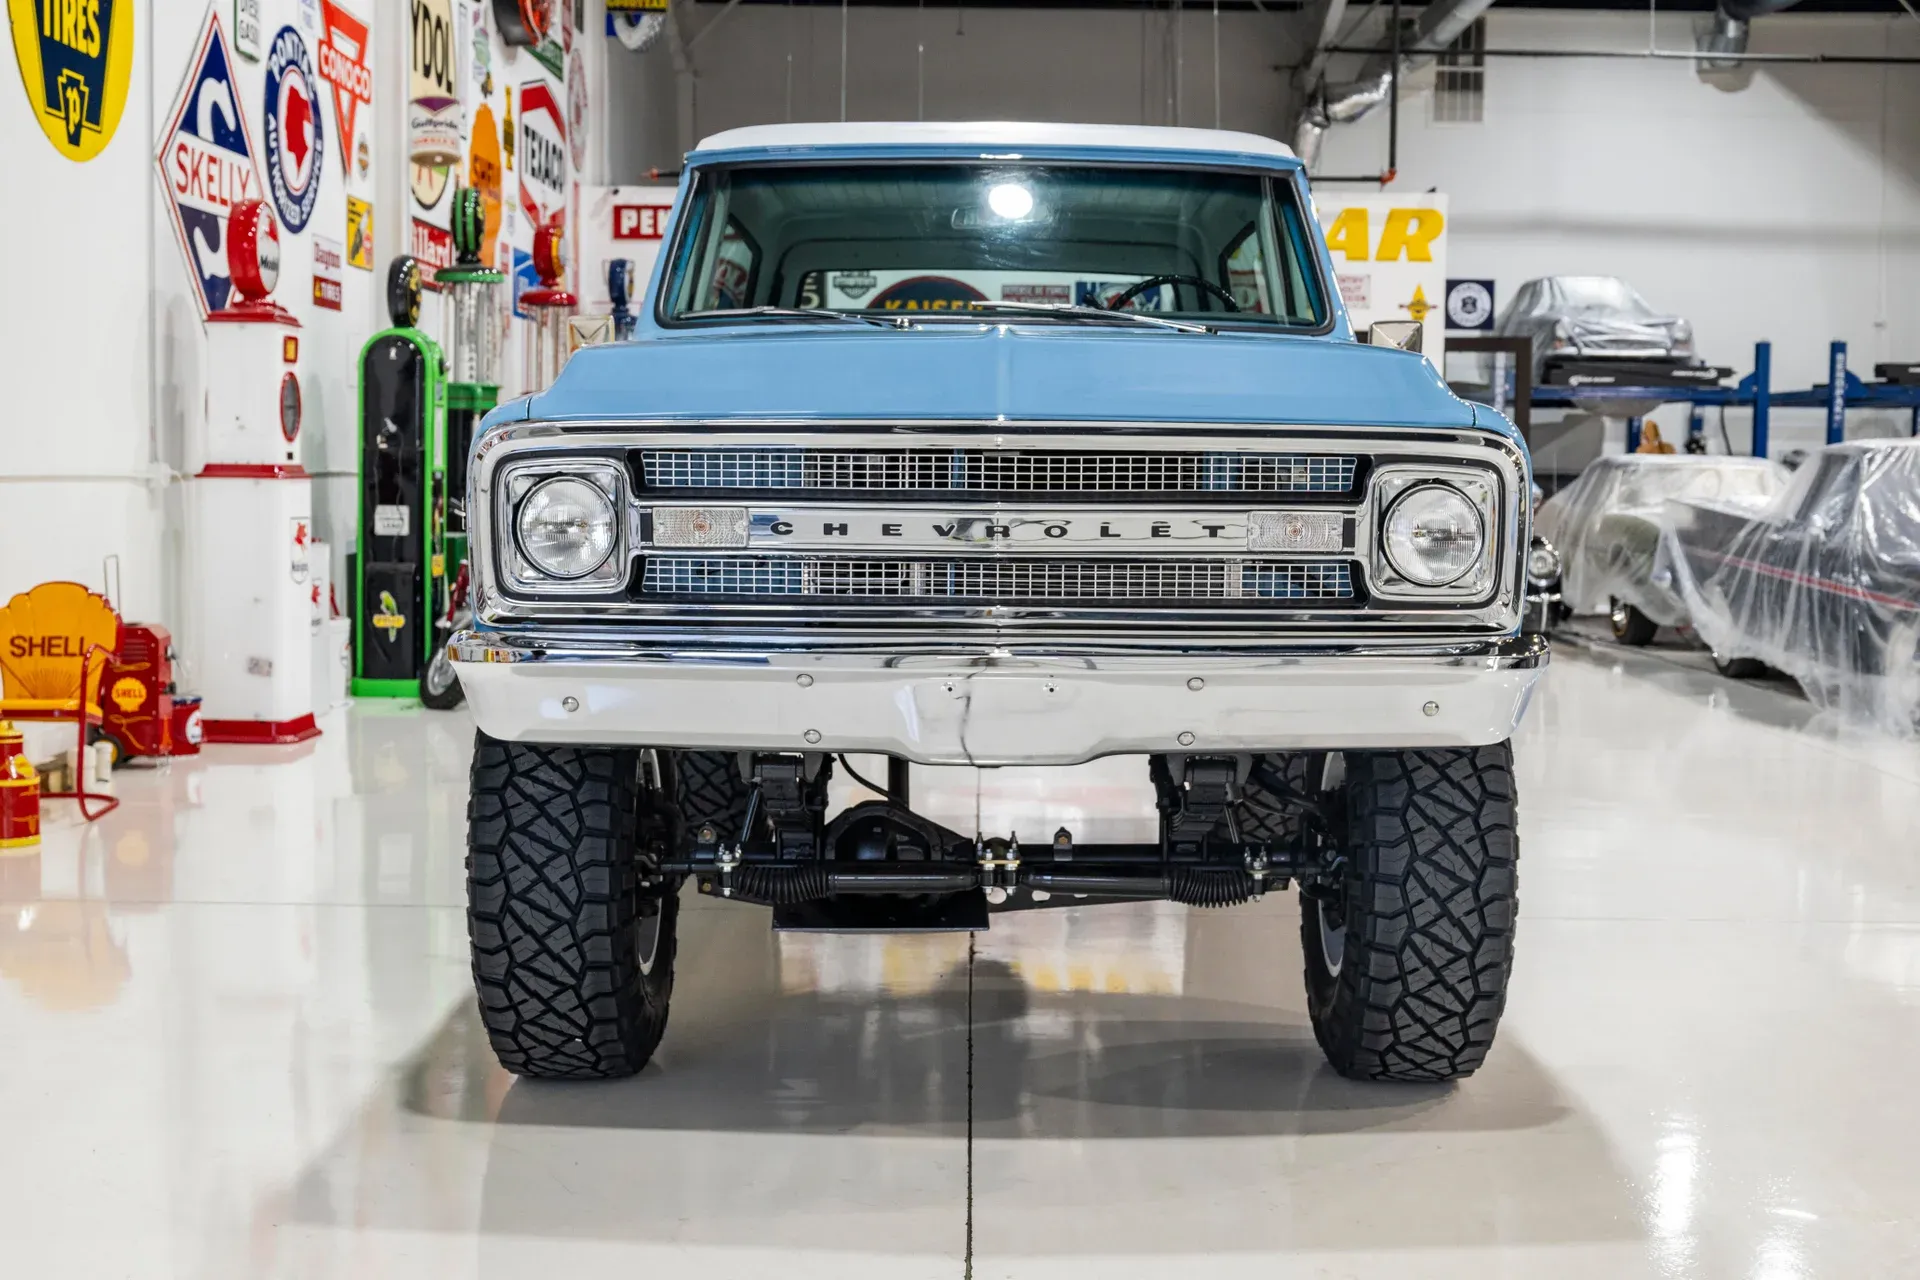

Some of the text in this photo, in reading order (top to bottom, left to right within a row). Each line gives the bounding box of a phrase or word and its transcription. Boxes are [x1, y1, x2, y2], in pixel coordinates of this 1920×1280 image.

[320, 43, 372, 99] CONOCO
[176, 142, 250, 206] SKELLY
[523, 124, 564, 194] TEXACO
[770, 519, 1227, 539] CHEVROLET
[9, 634, 87, 658] SHELL
[115, 688, 144, 699] SHELL
